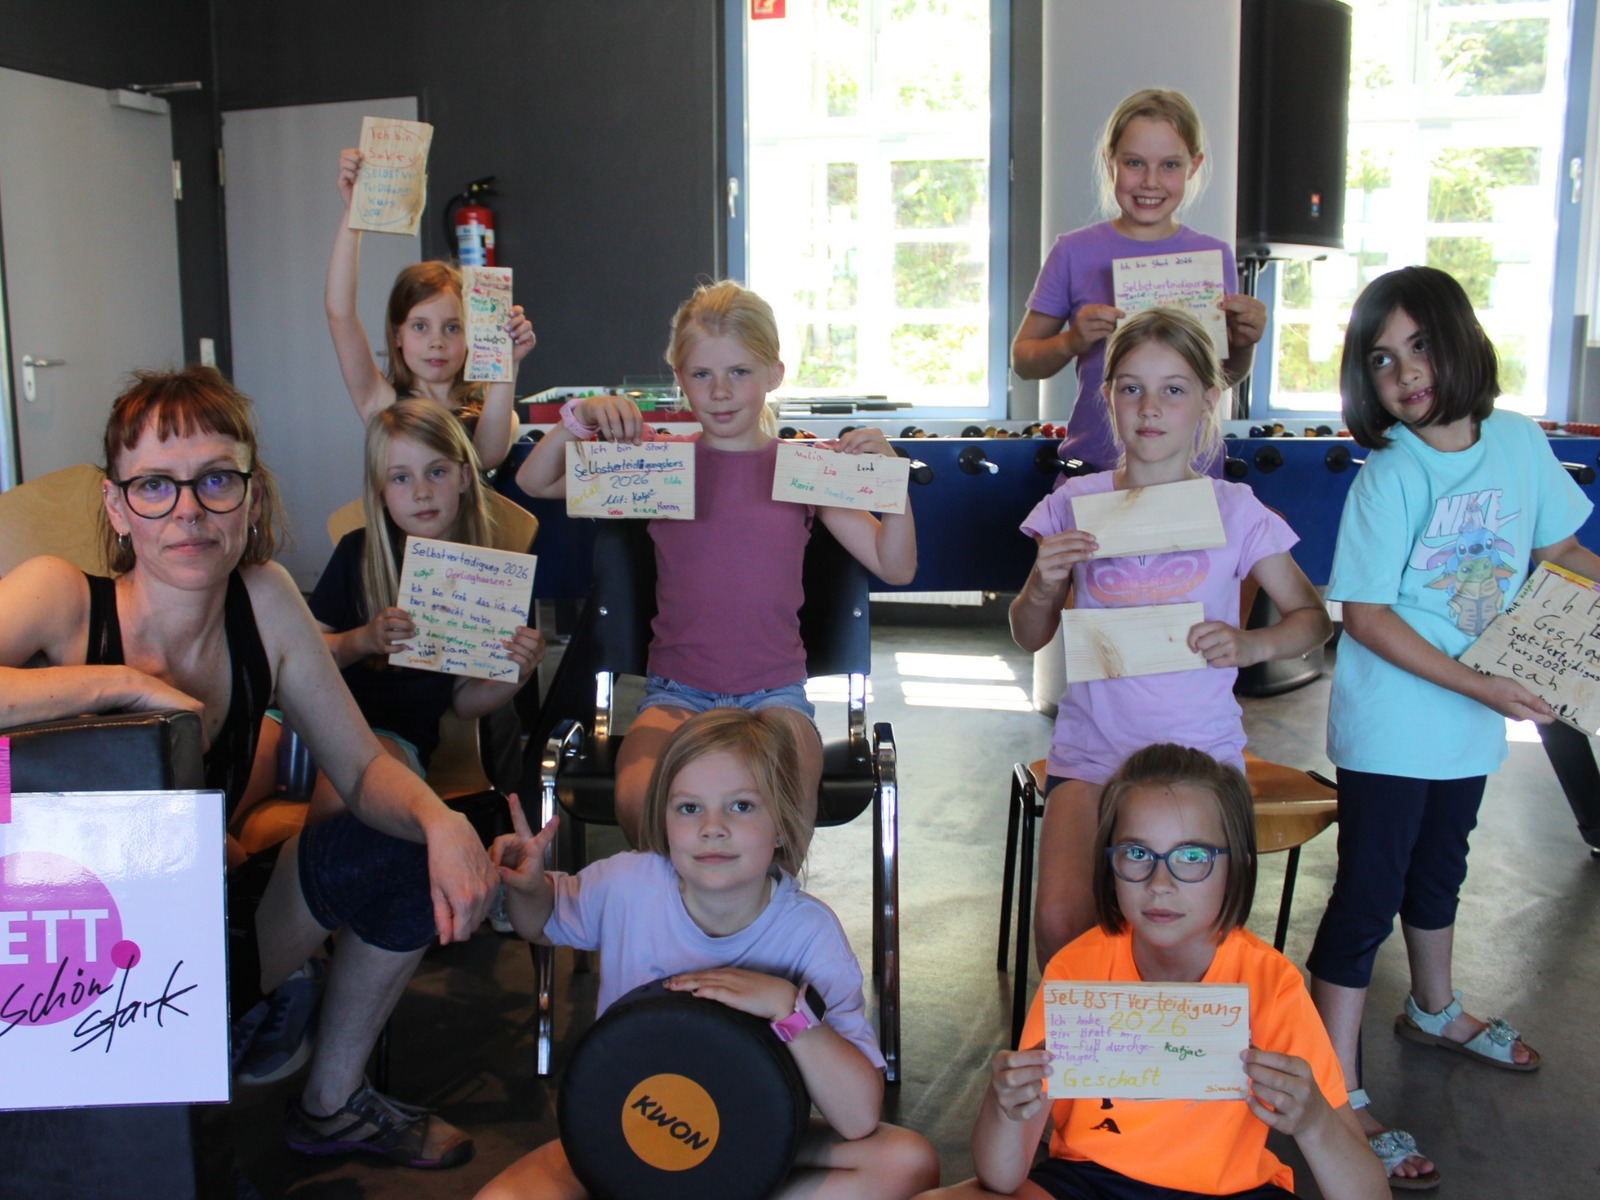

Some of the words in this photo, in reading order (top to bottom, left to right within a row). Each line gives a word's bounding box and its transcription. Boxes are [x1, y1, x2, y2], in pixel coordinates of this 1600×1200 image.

[590, 445, 607, 455] Ich
[616, 444, 632, 453] bin
[609, 474, 650, 489] 2026
[502, 562, 529, 580] 2026
[410, 583, 424, 594] Ich
[494, 601, 507, 613] ich
[1533, 613, 1600, 665] Gescha
[1495, 651, 1558, 692] Leah
[1534, 654, 1567, 676] 2026
[1050, 1013, 1067, 1027] Ich
[1109, 1010, 1189, 1037] 2026
[631, 1095, 710, 1150] KWON
